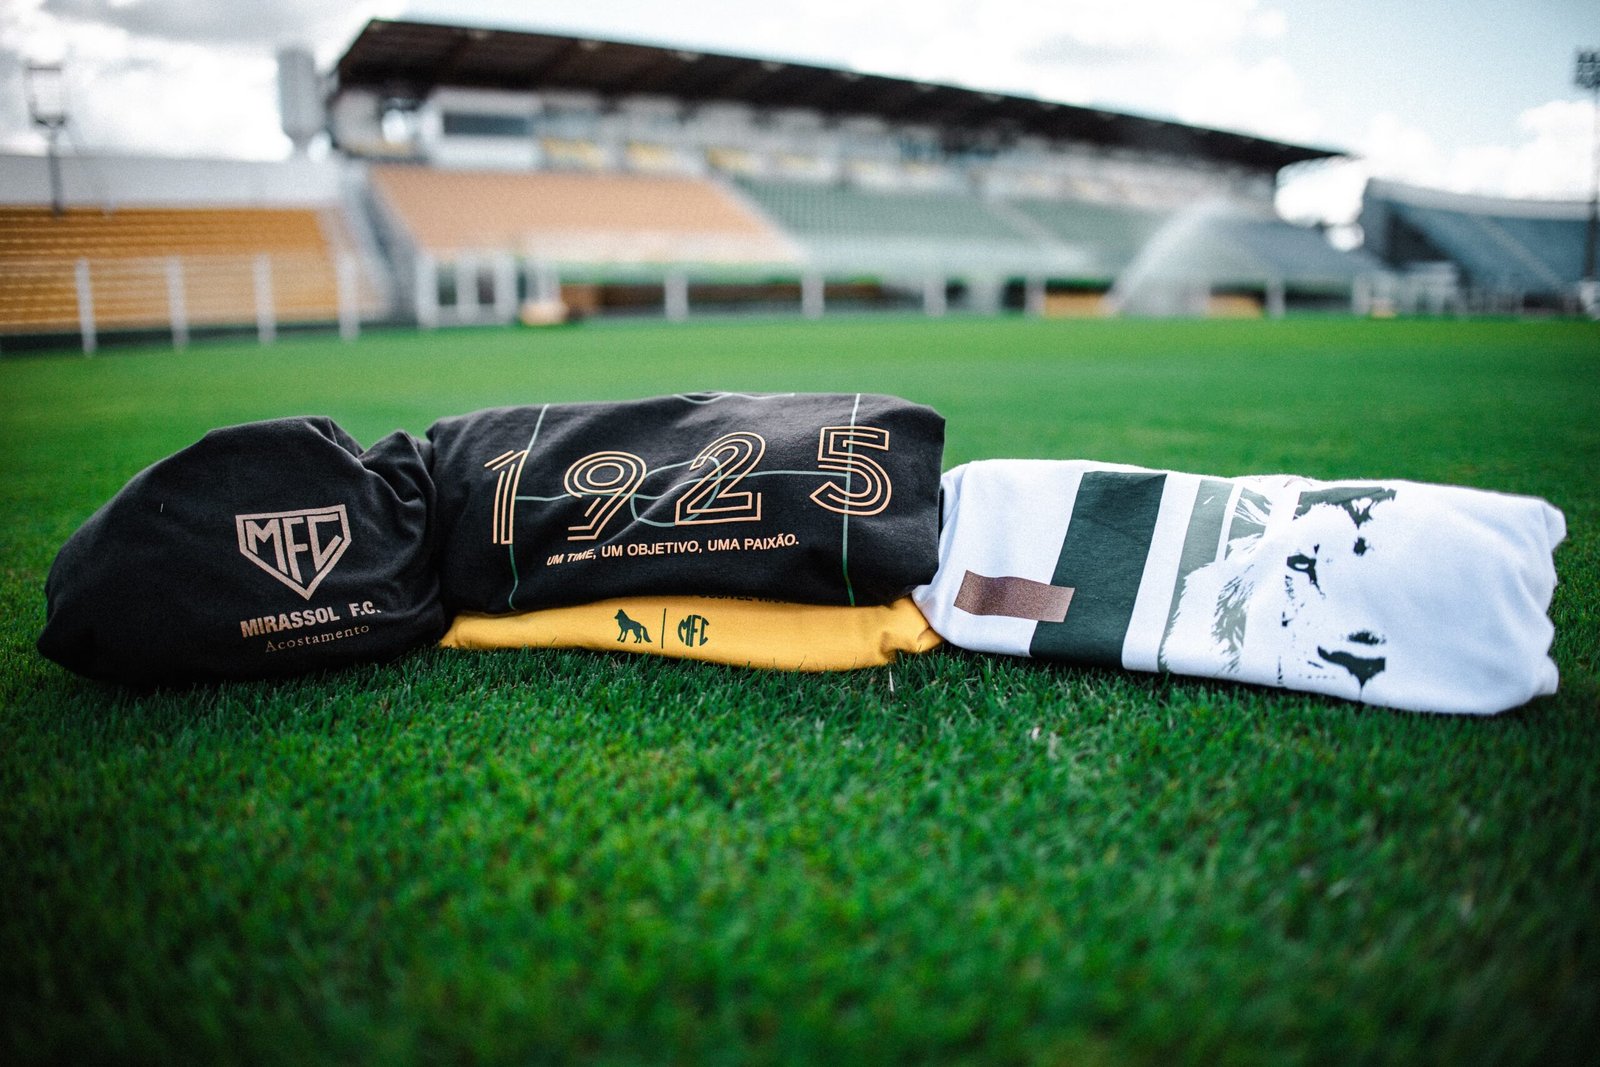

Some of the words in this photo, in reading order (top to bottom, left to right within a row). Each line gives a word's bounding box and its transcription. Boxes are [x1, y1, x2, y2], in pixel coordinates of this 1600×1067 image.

[483, 425, 892, 545] 1925
[244, 512, 344, 584] MFC
[546, 553, 565, 566] UM
[566, 548, 597, 563] TIME,
[601, 544, 624, 558] UM
[626, 540, 703, 556] OBJETIVO,
[707, 538, 741, 552] UMA
[744, 533, 800, 550] PAIXÃO.
[240, 606, 341, 638] MIRASSOL
[348, 600, 382, 617] F.C.
[677, 614, 710, 648] MFC
[265, 624, 370, 653] Acostamento
